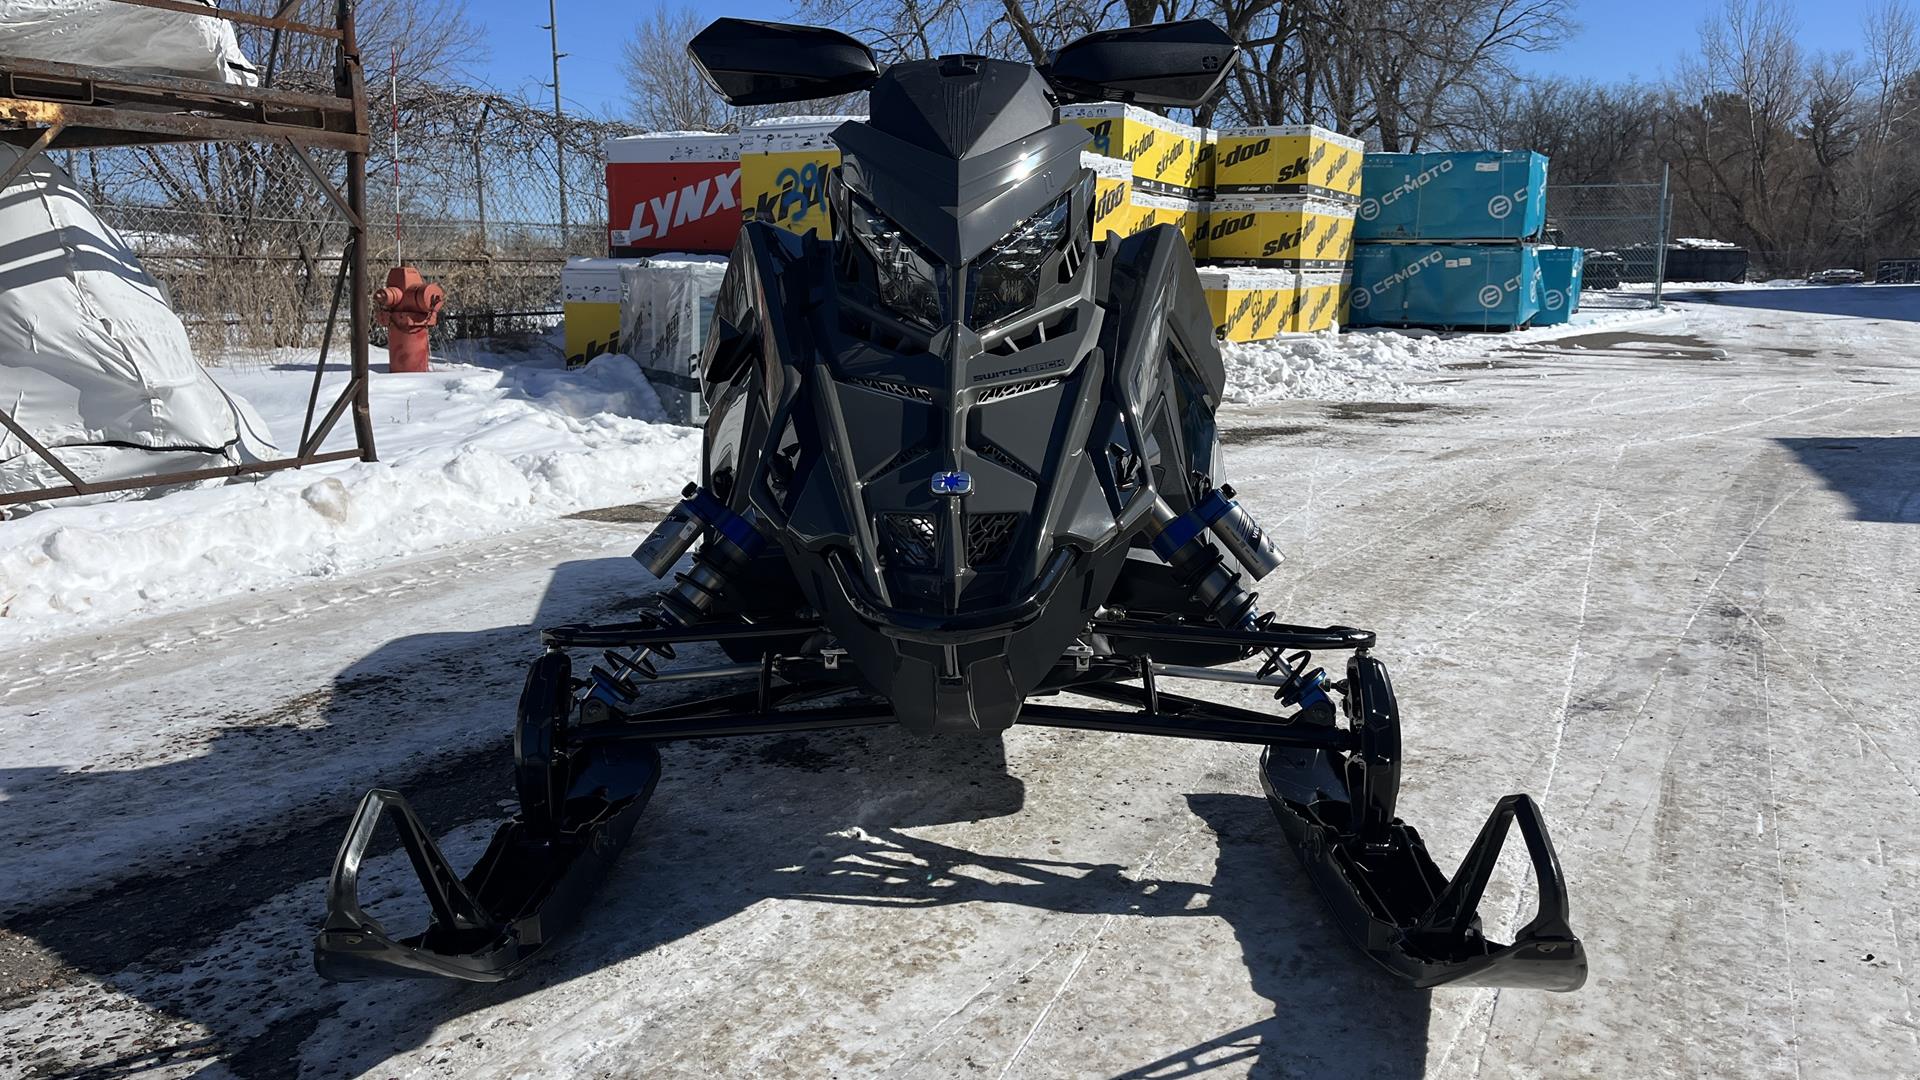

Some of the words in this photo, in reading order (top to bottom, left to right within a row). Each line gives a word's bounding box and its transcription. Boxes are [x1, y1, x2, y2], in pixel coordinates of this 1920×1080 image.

[1155, 139, 1185, 179] ski-doo
[629, 167, 741, 243] LYNX
[1381, 159, 1453, 206] CFMOTO
[1371, 250, 1444, 295] CFMOTO
[973, 358, 1067, 383] SWITCHBACK
